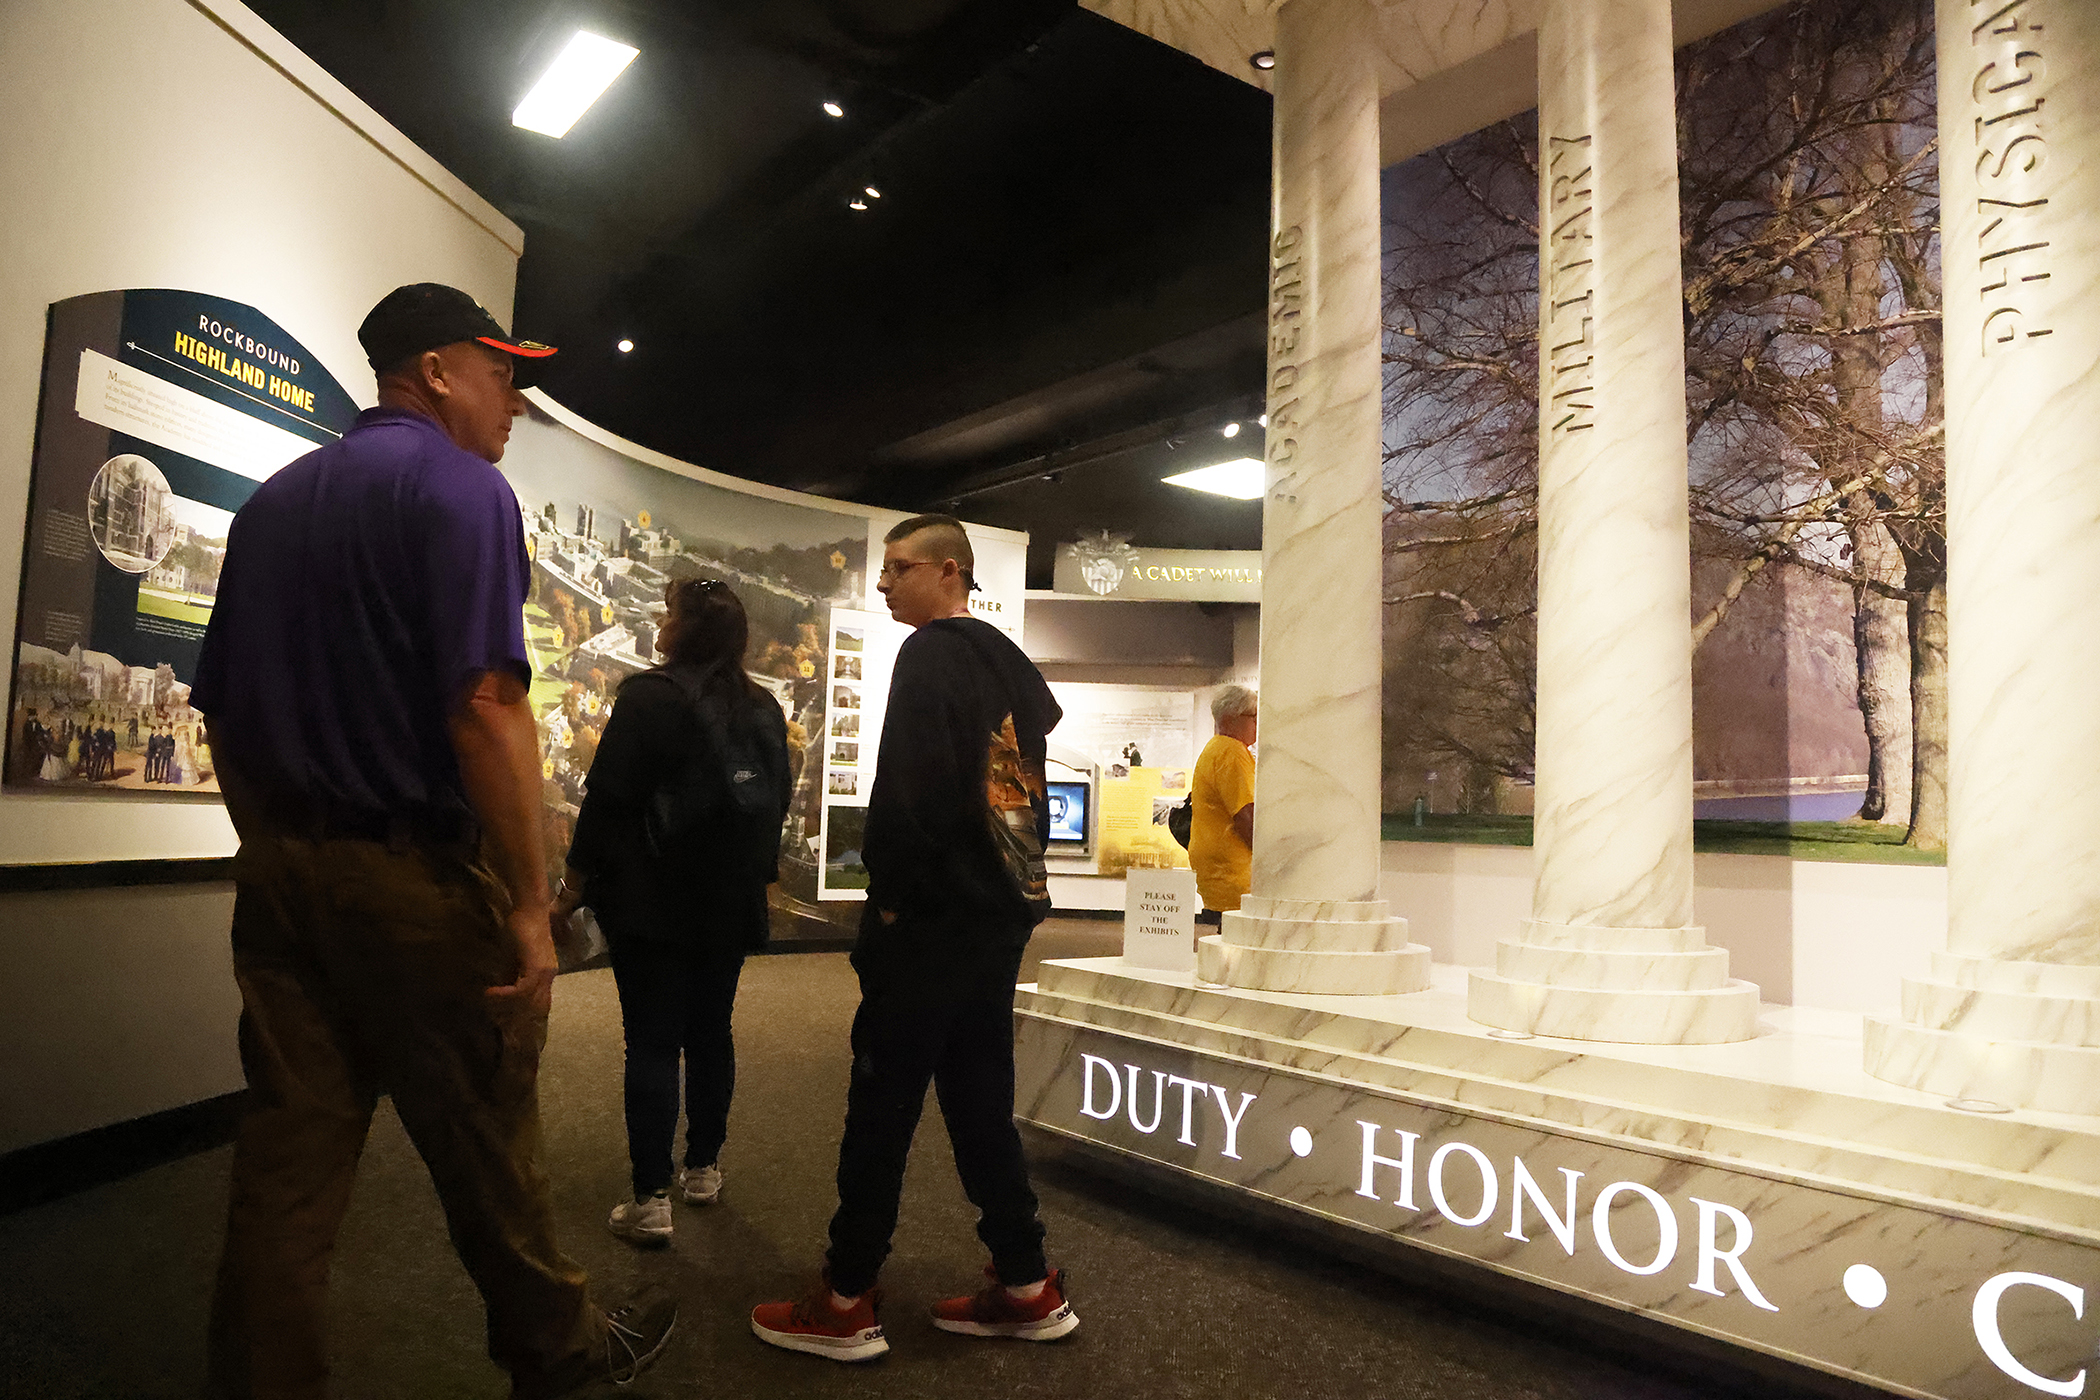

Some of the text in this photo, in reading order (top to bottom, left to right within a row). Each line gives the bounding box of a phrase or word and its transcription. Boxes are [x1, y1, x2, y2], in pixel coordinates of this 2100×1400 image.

[1970, 0, 2054, 357] PHYSICA
[1549, 134, 1594, 439] MILITARY
[174, 331, 316, 413] HIGHLAND HOME
[199, 314, 300, 375] ROCKBOUND
[1267, 225, 1303, 503] ACADEMIC
[1132, 565, 1144, 581] A
[1146, 565, 1206, 582] CADET
[1209, 566, 1253, 583] WILL
[1139, 903, 1181, 913] STAY OFF
[1144, 891, 1176, 901] PLEASE
[1151, 915, 1169, 924] THE
[1139, 926, 1180, 936] EXHIBITS
[1080, 1053, 2087, 1398] DUTY HONOR C
